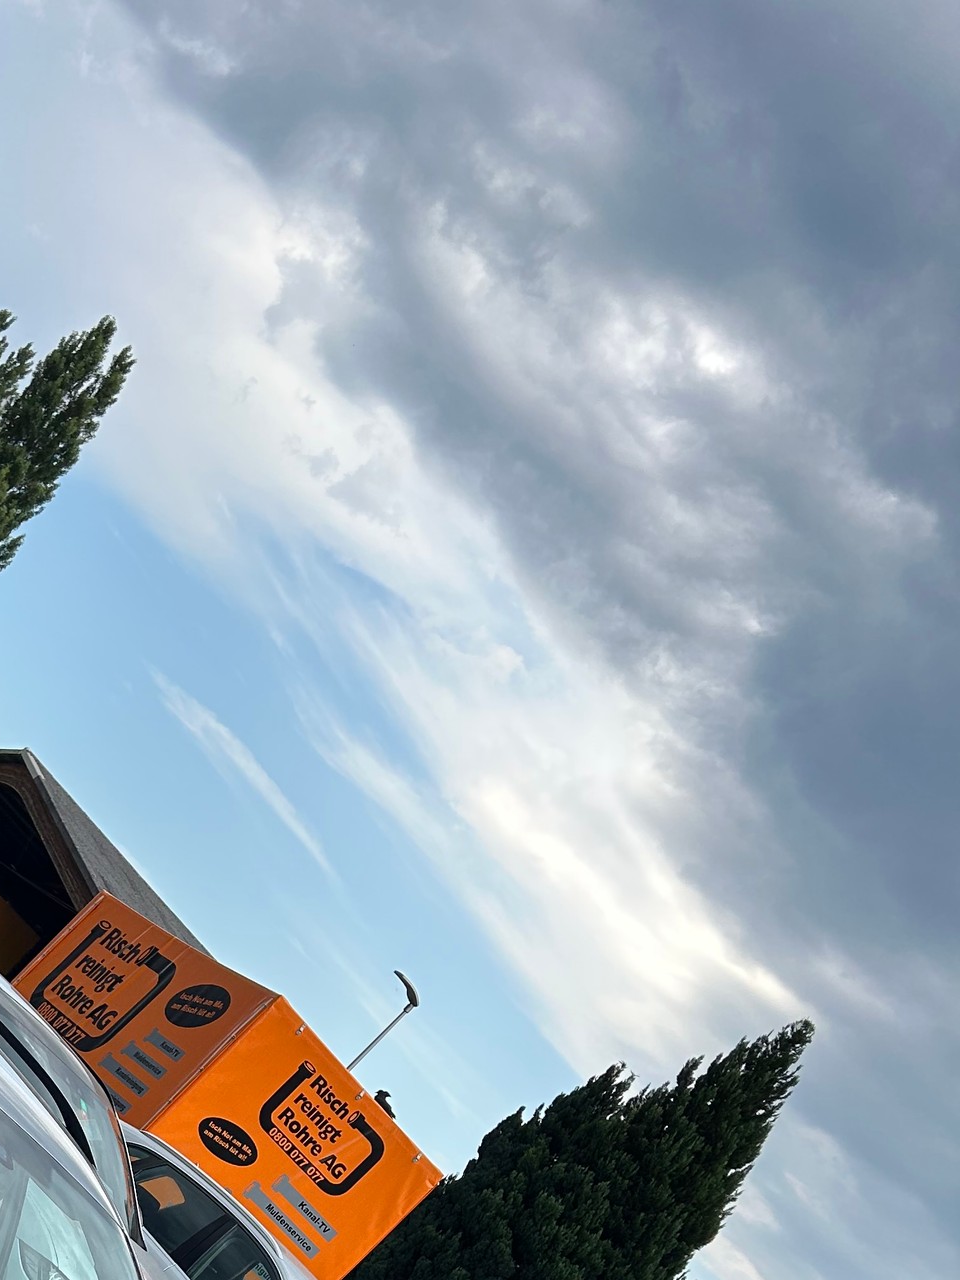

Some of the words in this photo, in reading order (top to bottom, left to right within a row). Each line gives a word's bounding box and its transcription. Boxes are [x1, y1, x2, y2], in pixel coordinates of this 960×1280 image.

[99, 927, 141, 964] Risch
[75, 954, 125, 993] reinigt
[37, 1001, 58, 1021] 0800
[56, 1015, 73, 1033] 077
[51, 974, 94, 1014] Rohre
[85, 1003, 118, 1031] AG
[293, 1093, 342, 1143] reinigt
[309, 1074, 350, 1120] Risch
[213, 1135, 229, 1149] Risch
[269, 1127, 292, 1151] 0800
[290, 1150, 308, 1168] 077
[306, 1166, 325, 1184] 077
[277, 1106, 322, 1157] Rohre
[319, 1154, 347, 1180] AG
[265, 1203, 312, 1252] Muldenservice
[298, 1201, 331, 1234] Kanal-TV
